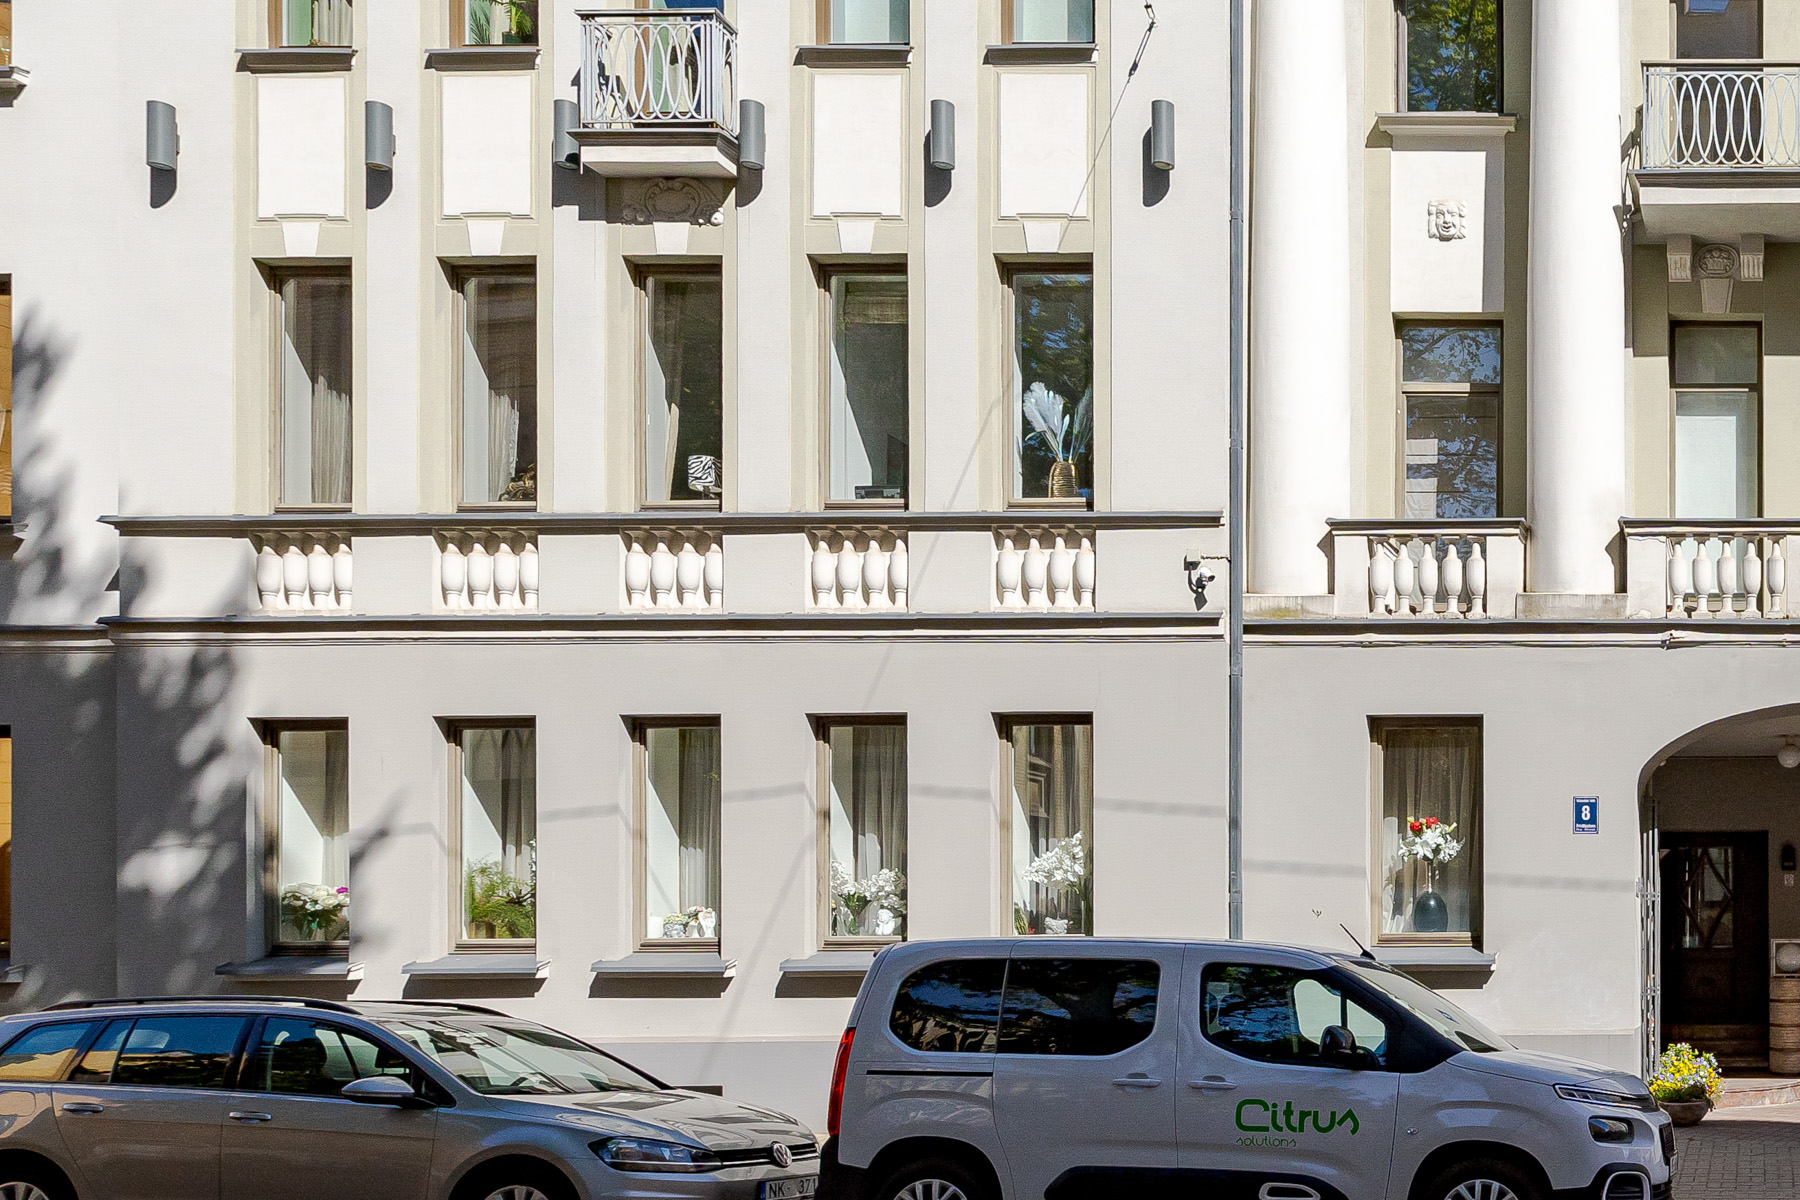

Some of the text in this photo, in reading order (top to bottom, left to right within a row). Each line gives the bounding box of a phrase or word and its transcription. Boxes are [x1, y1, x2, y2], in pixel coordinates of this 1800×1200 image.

[1581, 805, 1591, 821] 8
[1235, 1098, 1360, 1136] Citrus
[1235, 1135, 1297, 1148] solutions
